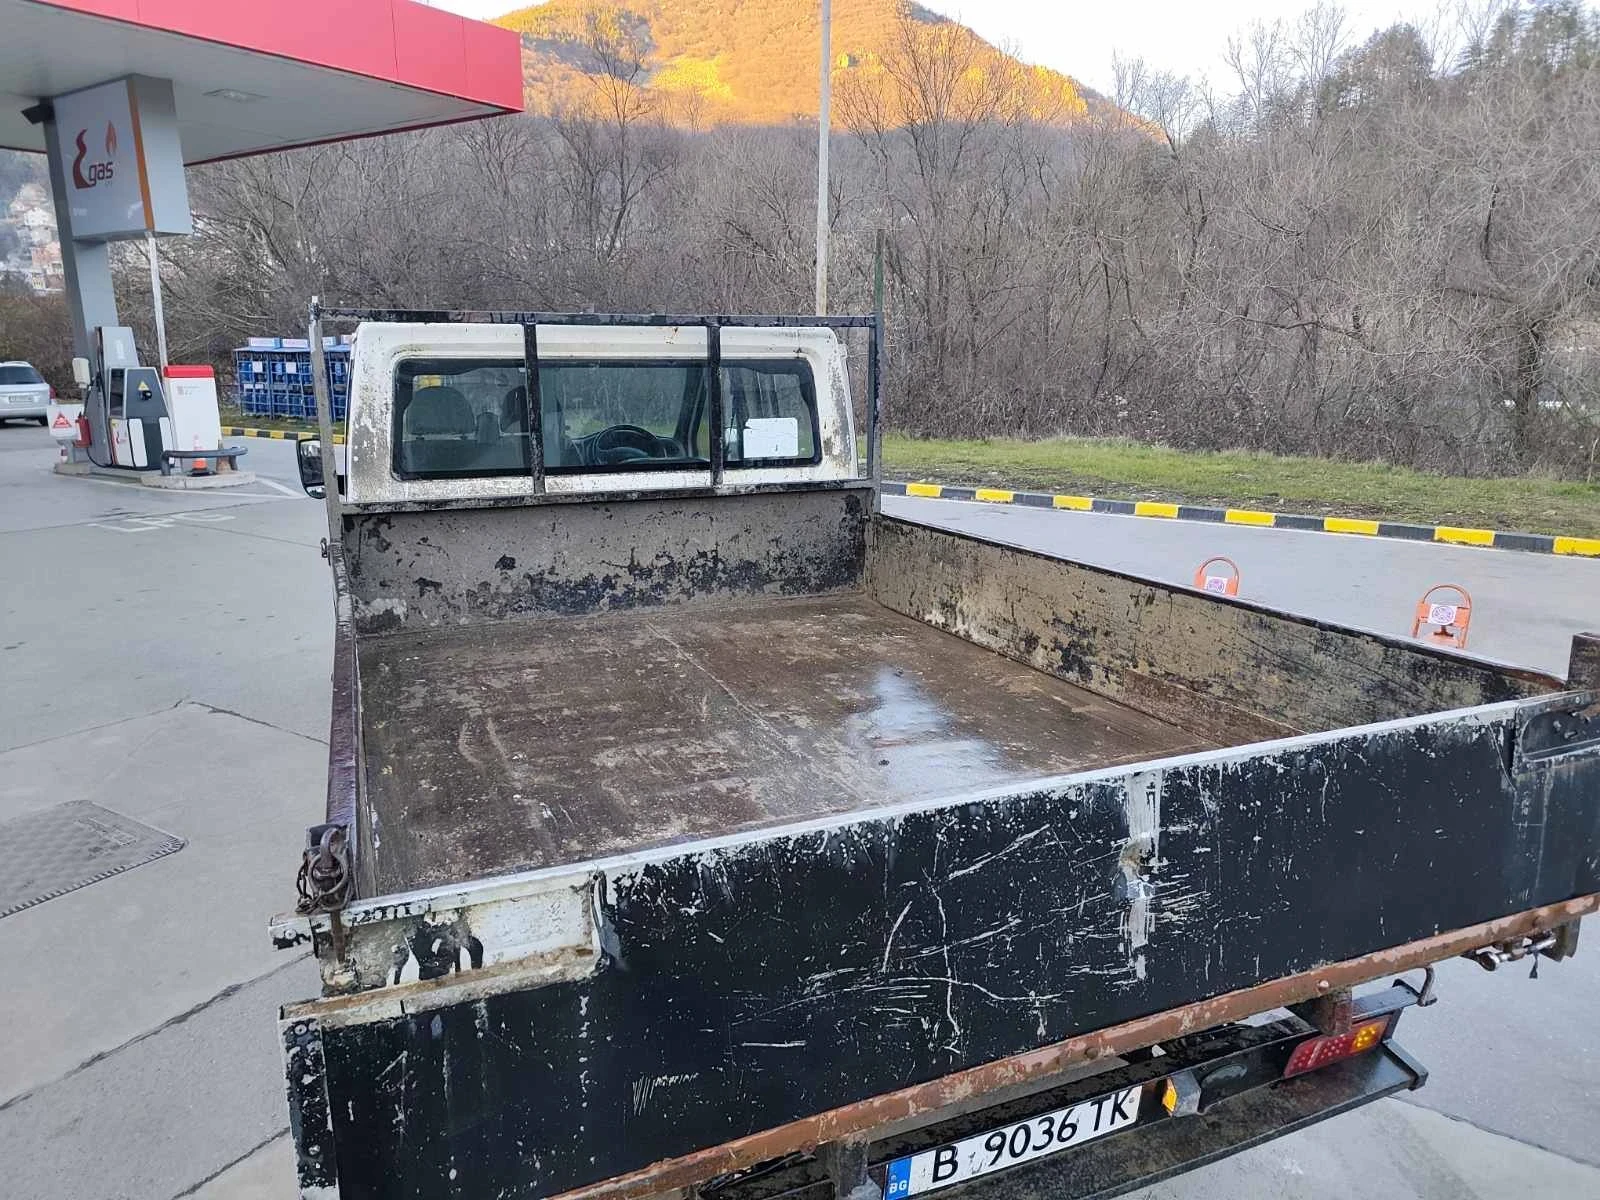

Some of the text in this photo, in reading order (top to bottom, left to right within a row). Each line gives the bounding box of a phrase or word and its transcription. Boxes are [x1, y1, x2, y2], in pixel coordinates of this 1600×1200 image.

[932, 1087, 1135, 1184] B 9036 TK
[888, 1179, 908, 1195] BG
